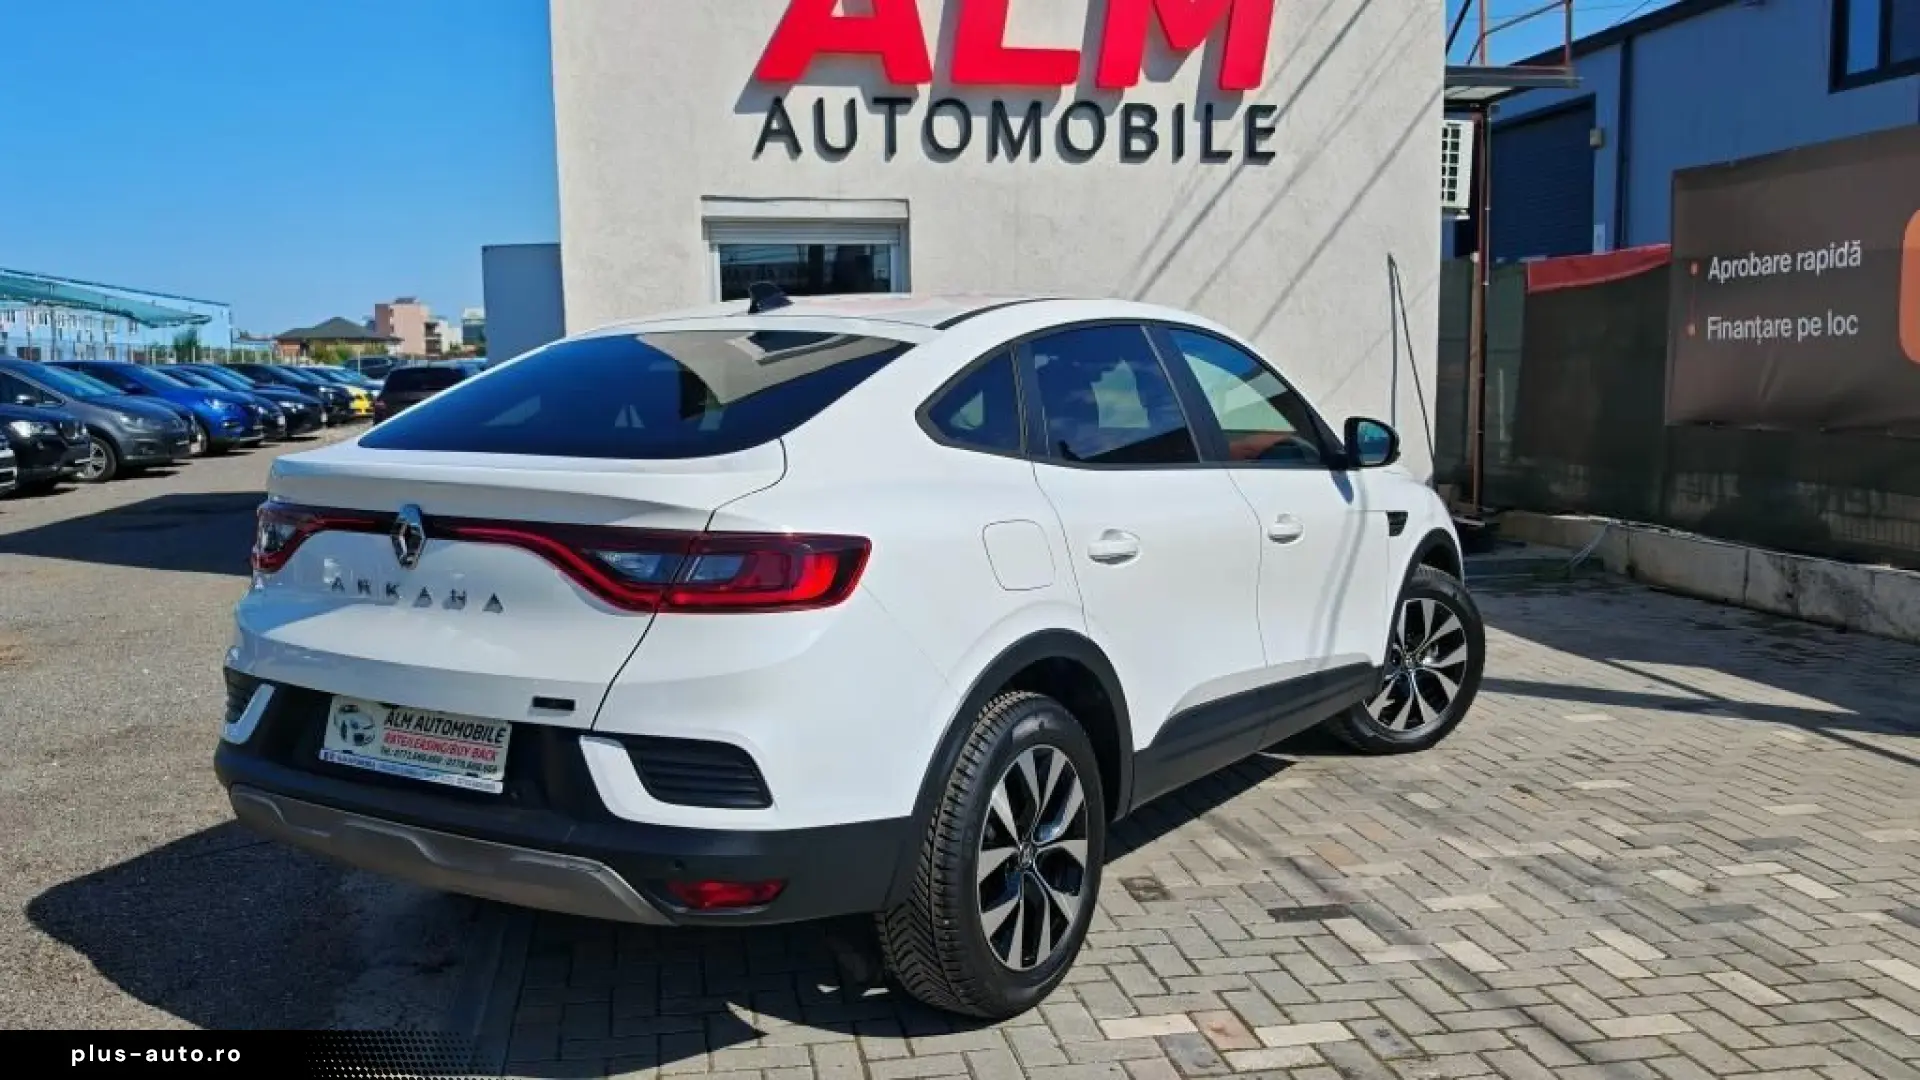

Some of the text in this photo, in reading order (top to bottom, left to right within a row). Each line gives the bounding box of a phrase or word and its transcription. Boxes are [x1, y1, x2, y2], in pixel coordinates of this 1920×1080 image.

[755, 0, 1274, 91] ALM
[753, 97, 1277, 163] AUTOMOBILE
[1708, 240, 1861, 285] Aprobare rapidă
[1707, 309, 1859, 345] Finanțare pe loc
[331, 576, 504, 614] ARKANA
[384, 708, 507, 744] ALM AUTOMOBILE
